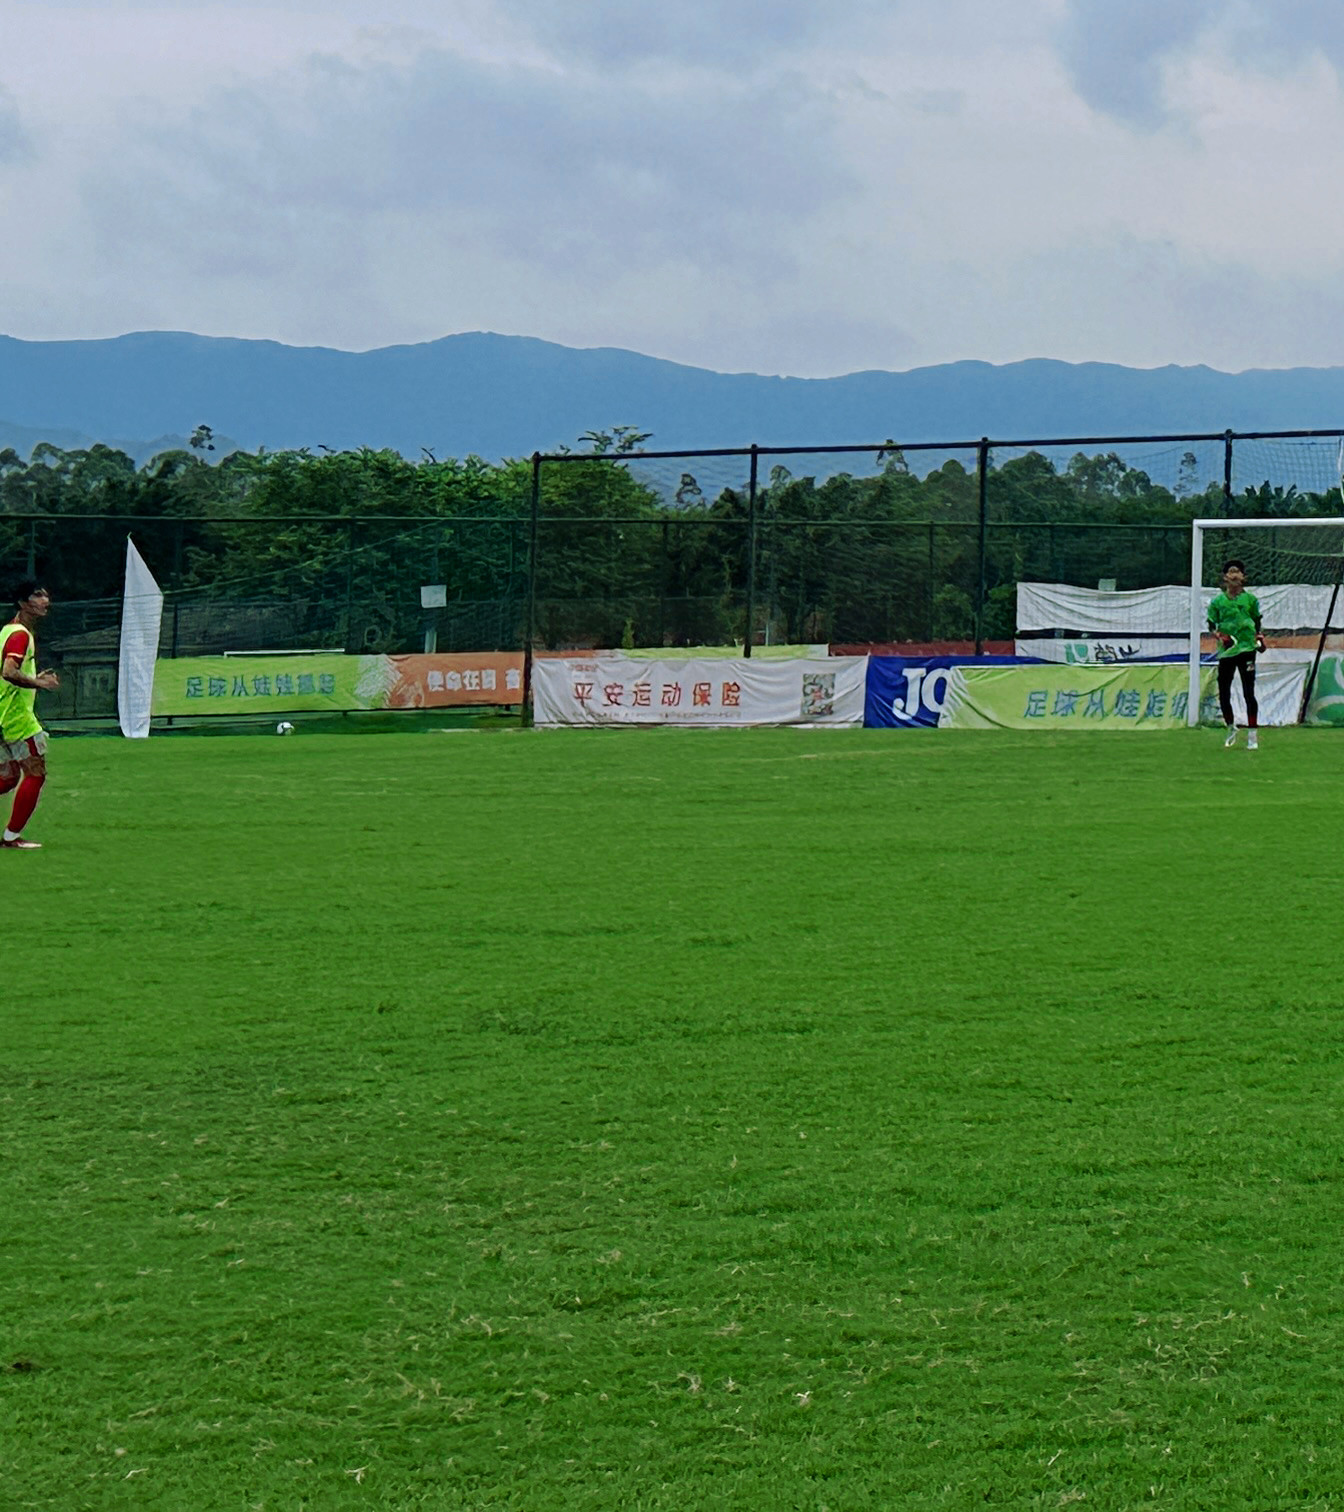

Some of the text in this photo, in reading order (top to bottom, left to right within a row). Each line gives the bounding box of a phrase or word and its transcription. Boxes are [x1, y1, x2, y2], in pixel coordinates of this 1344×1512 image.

[573, 681, 742, 707] 平安运动保险
